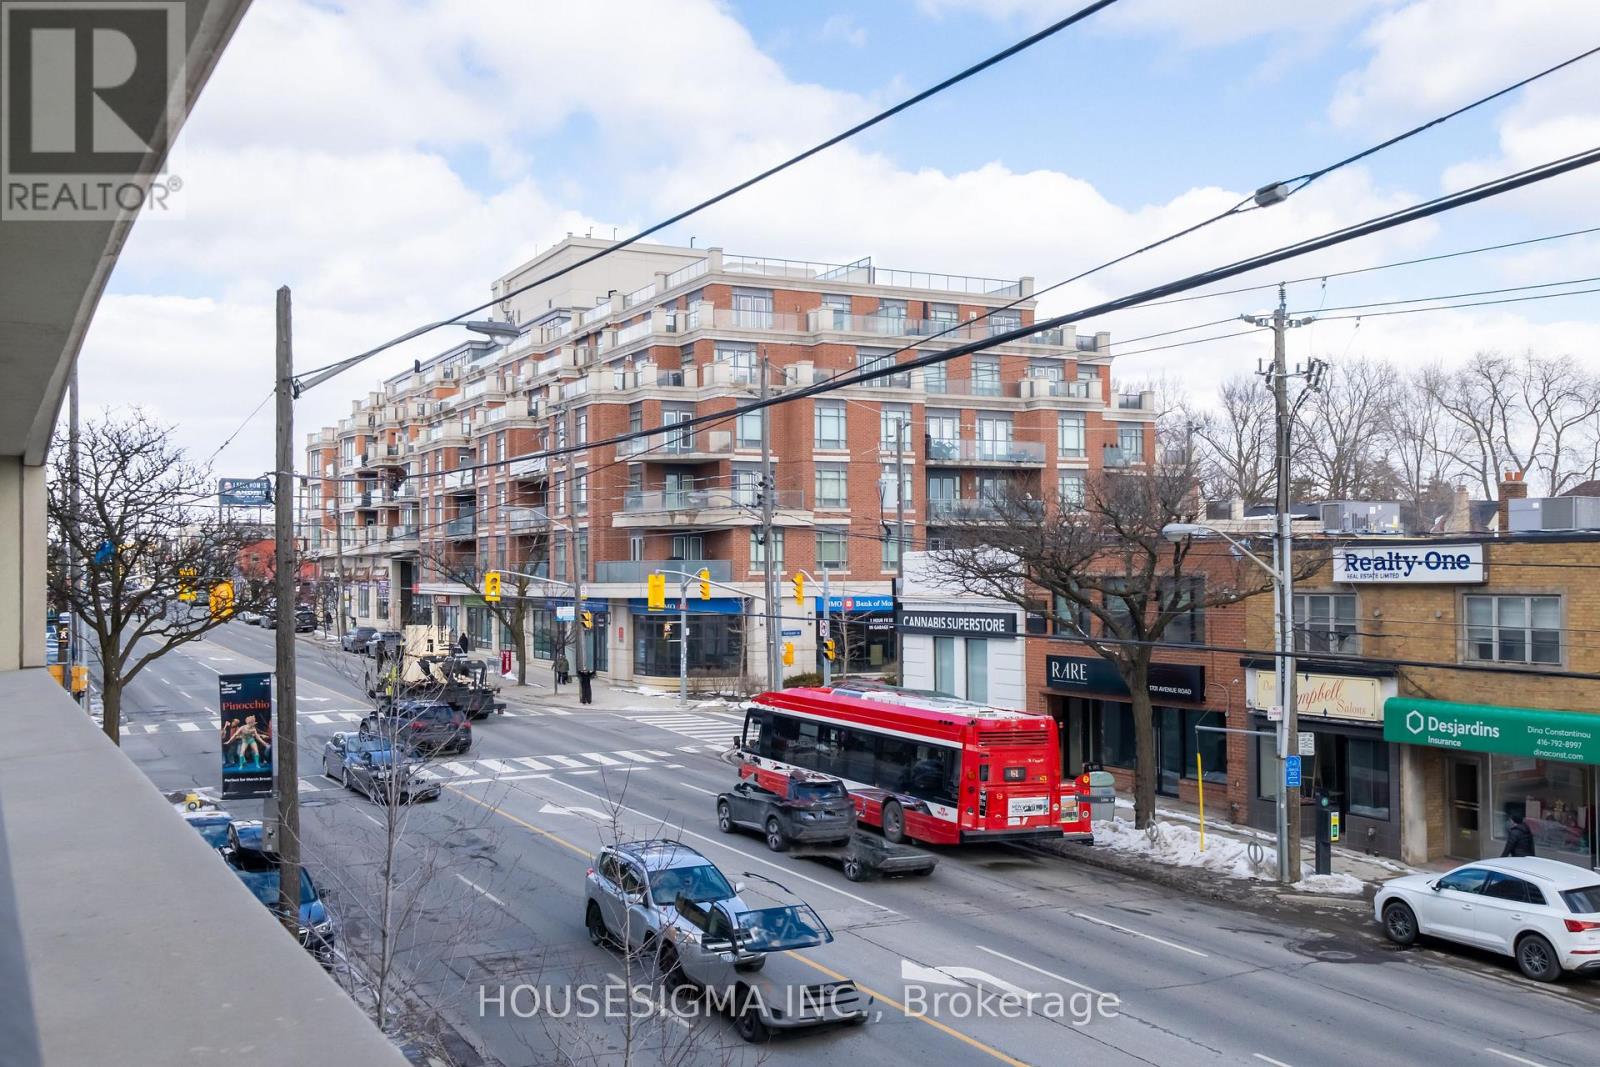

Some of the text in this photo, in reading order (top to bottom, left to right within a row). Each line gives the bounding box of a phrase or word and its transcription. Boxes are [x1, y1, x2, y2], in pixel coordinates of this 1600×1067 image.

[1344, 551, 1471, 577] Realty-One
[903, 616, 1005, 632] CANNABIS SUPERSTORE
[1051, 660, 1088, 681] RARE
[1177, 687, 1192, 695] ROAD
[222, 699, 270, 710] Pinocchio
[1428, 716, 1500, 738] Desjardins
[1527, 725, 1591, 739] Dino Constantinou
[1427, 735, 1462, 747] Insurance
[1536, 738, 1582, 750] 416-792-8997
